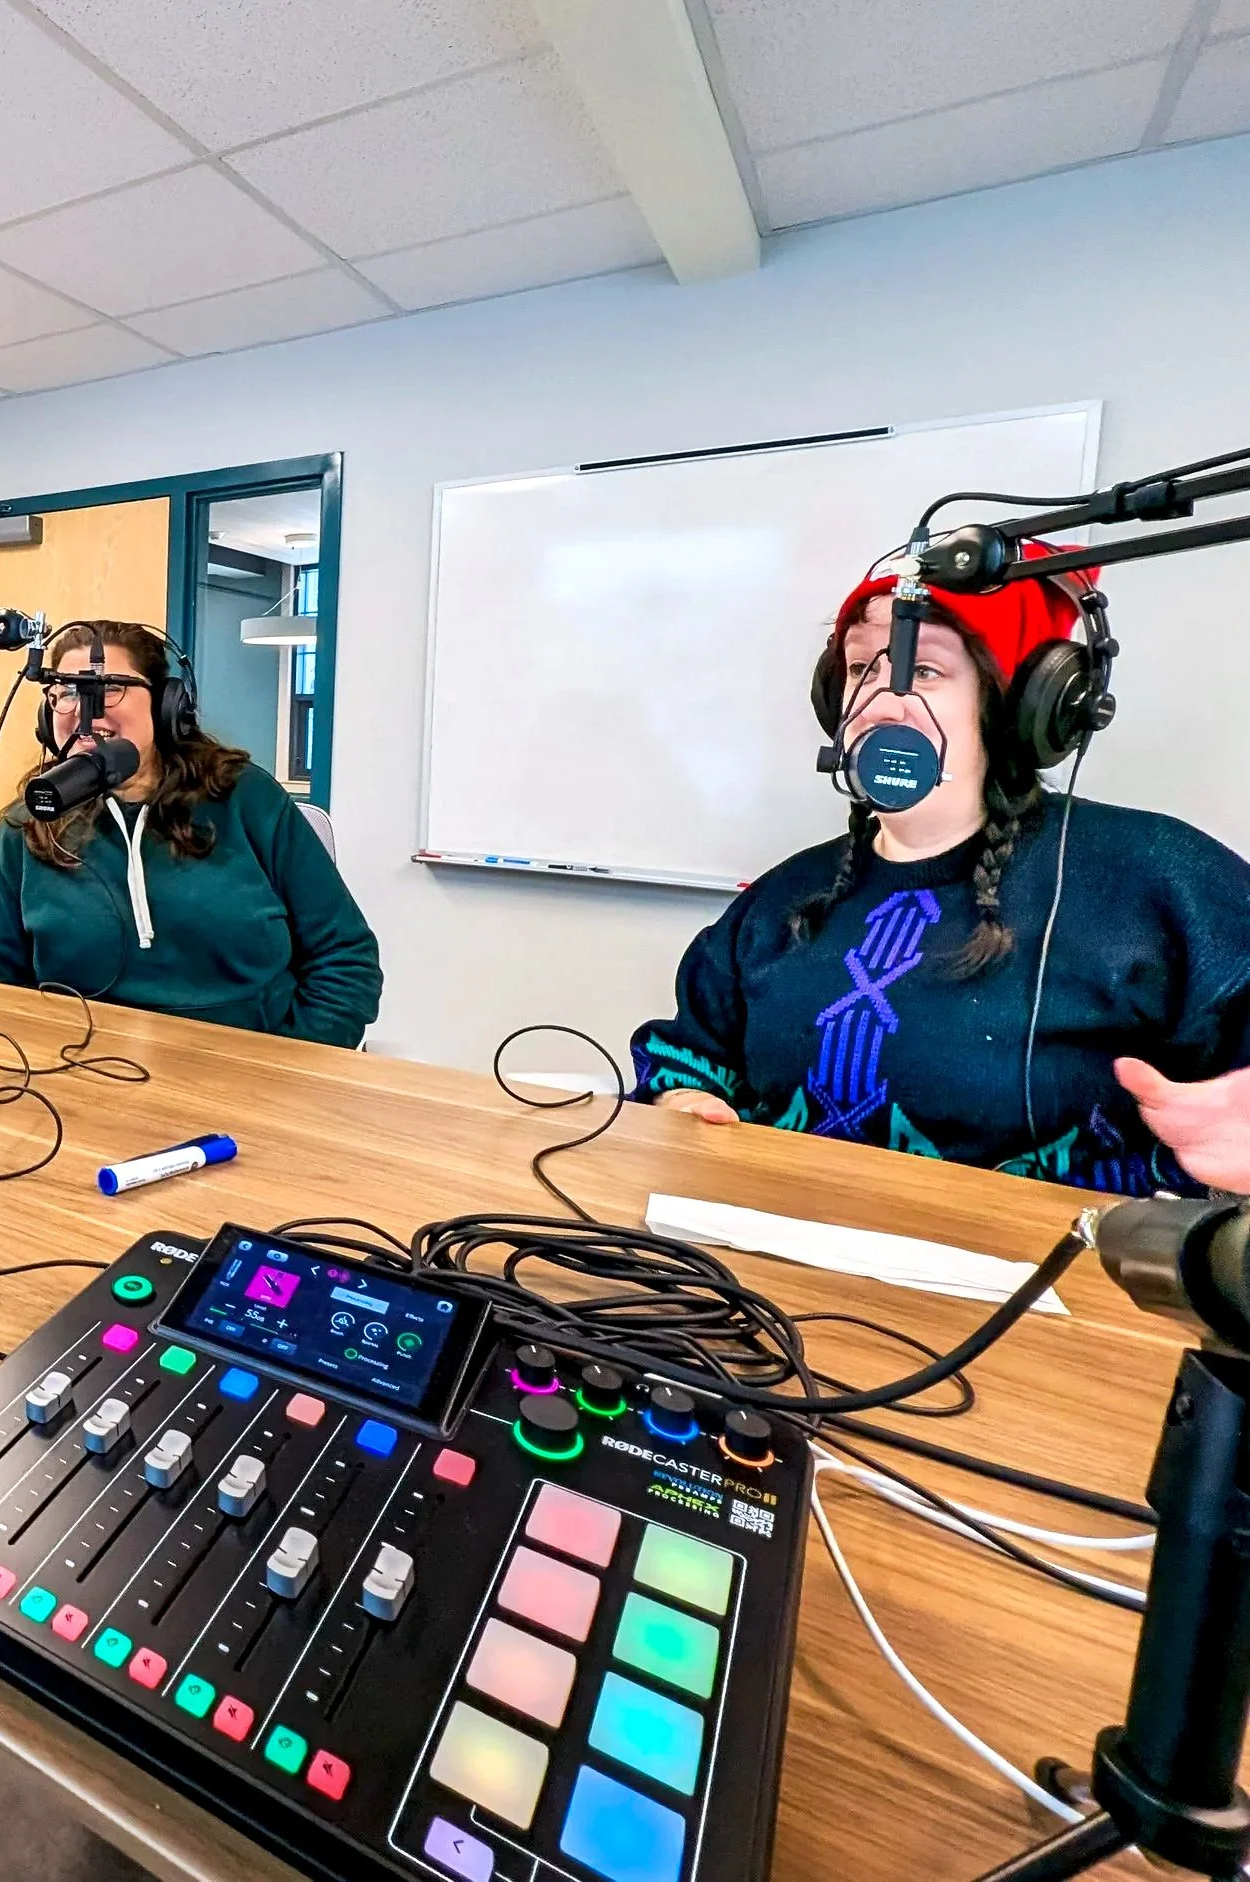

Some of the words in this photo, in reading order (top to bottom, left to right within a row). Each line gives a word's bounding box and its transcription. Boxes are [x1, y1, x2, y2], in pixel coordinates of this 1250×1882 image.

[873, 774, 918, 789] SHURE
[150, 1241, 199, 1263] RØDE
[650, 1484, 720, 1512] APHEX
